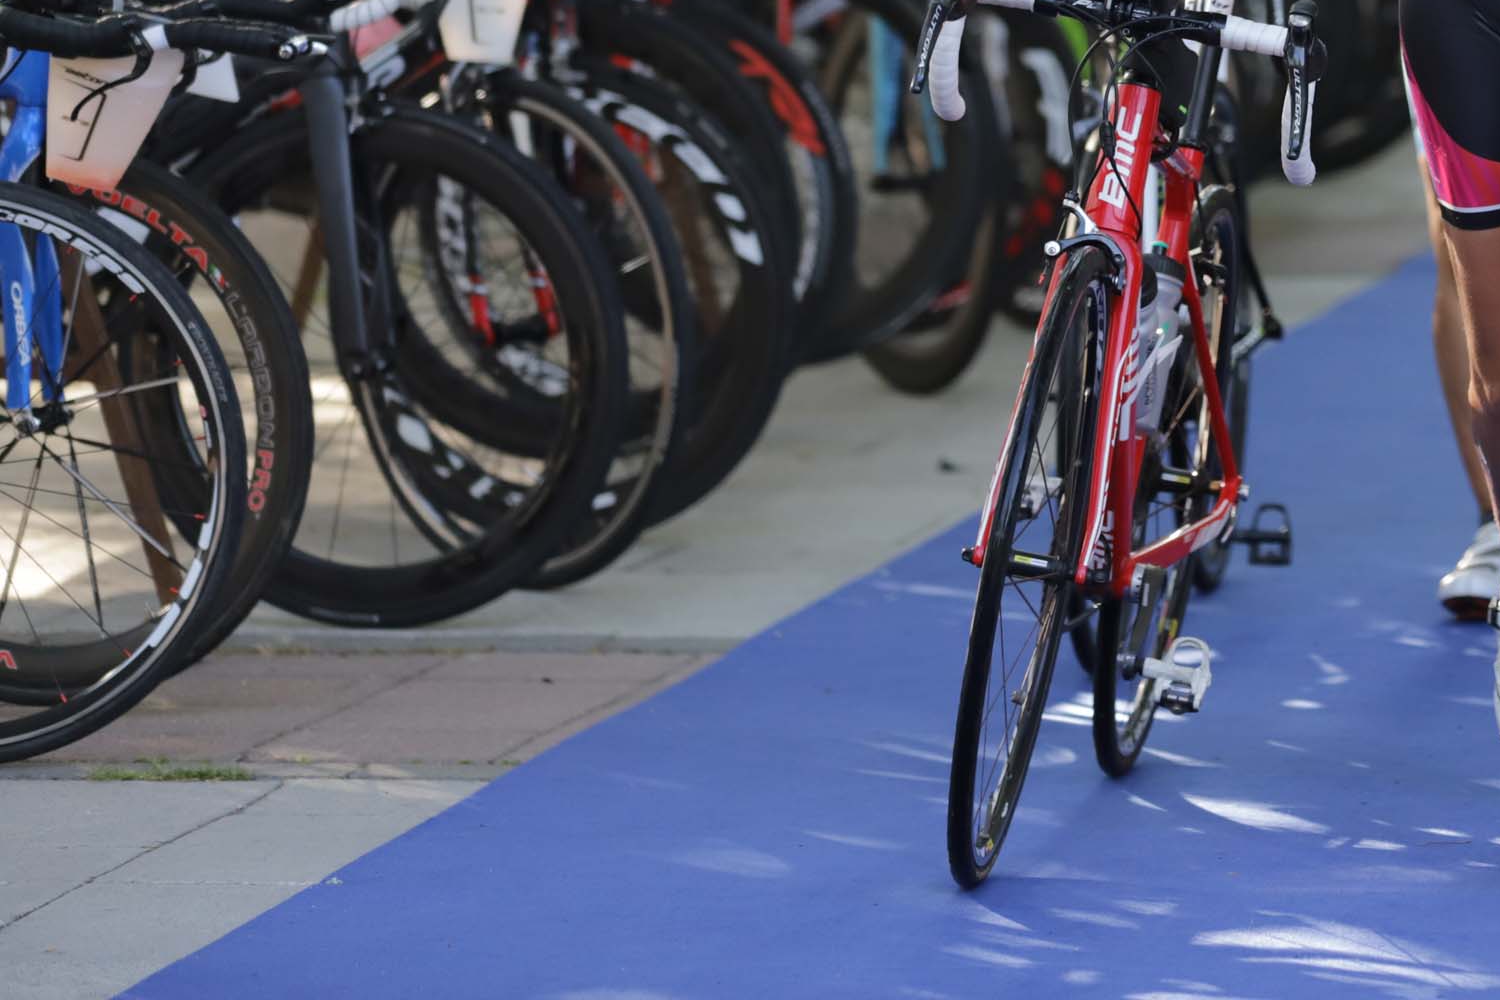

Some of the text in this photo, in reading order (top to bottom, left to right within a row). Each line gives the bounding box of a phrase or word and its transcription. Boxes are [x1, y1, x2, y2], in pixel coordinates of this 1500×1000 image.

[918, 3, 942, 68] ULTEGRA
[1292, 66, 1303, 135] ULTEGRA
[1097, 105, 1143, 210] BMC
[10, 280, 31, 367] ORBEA
[247, 449, 274, 513] PRO
